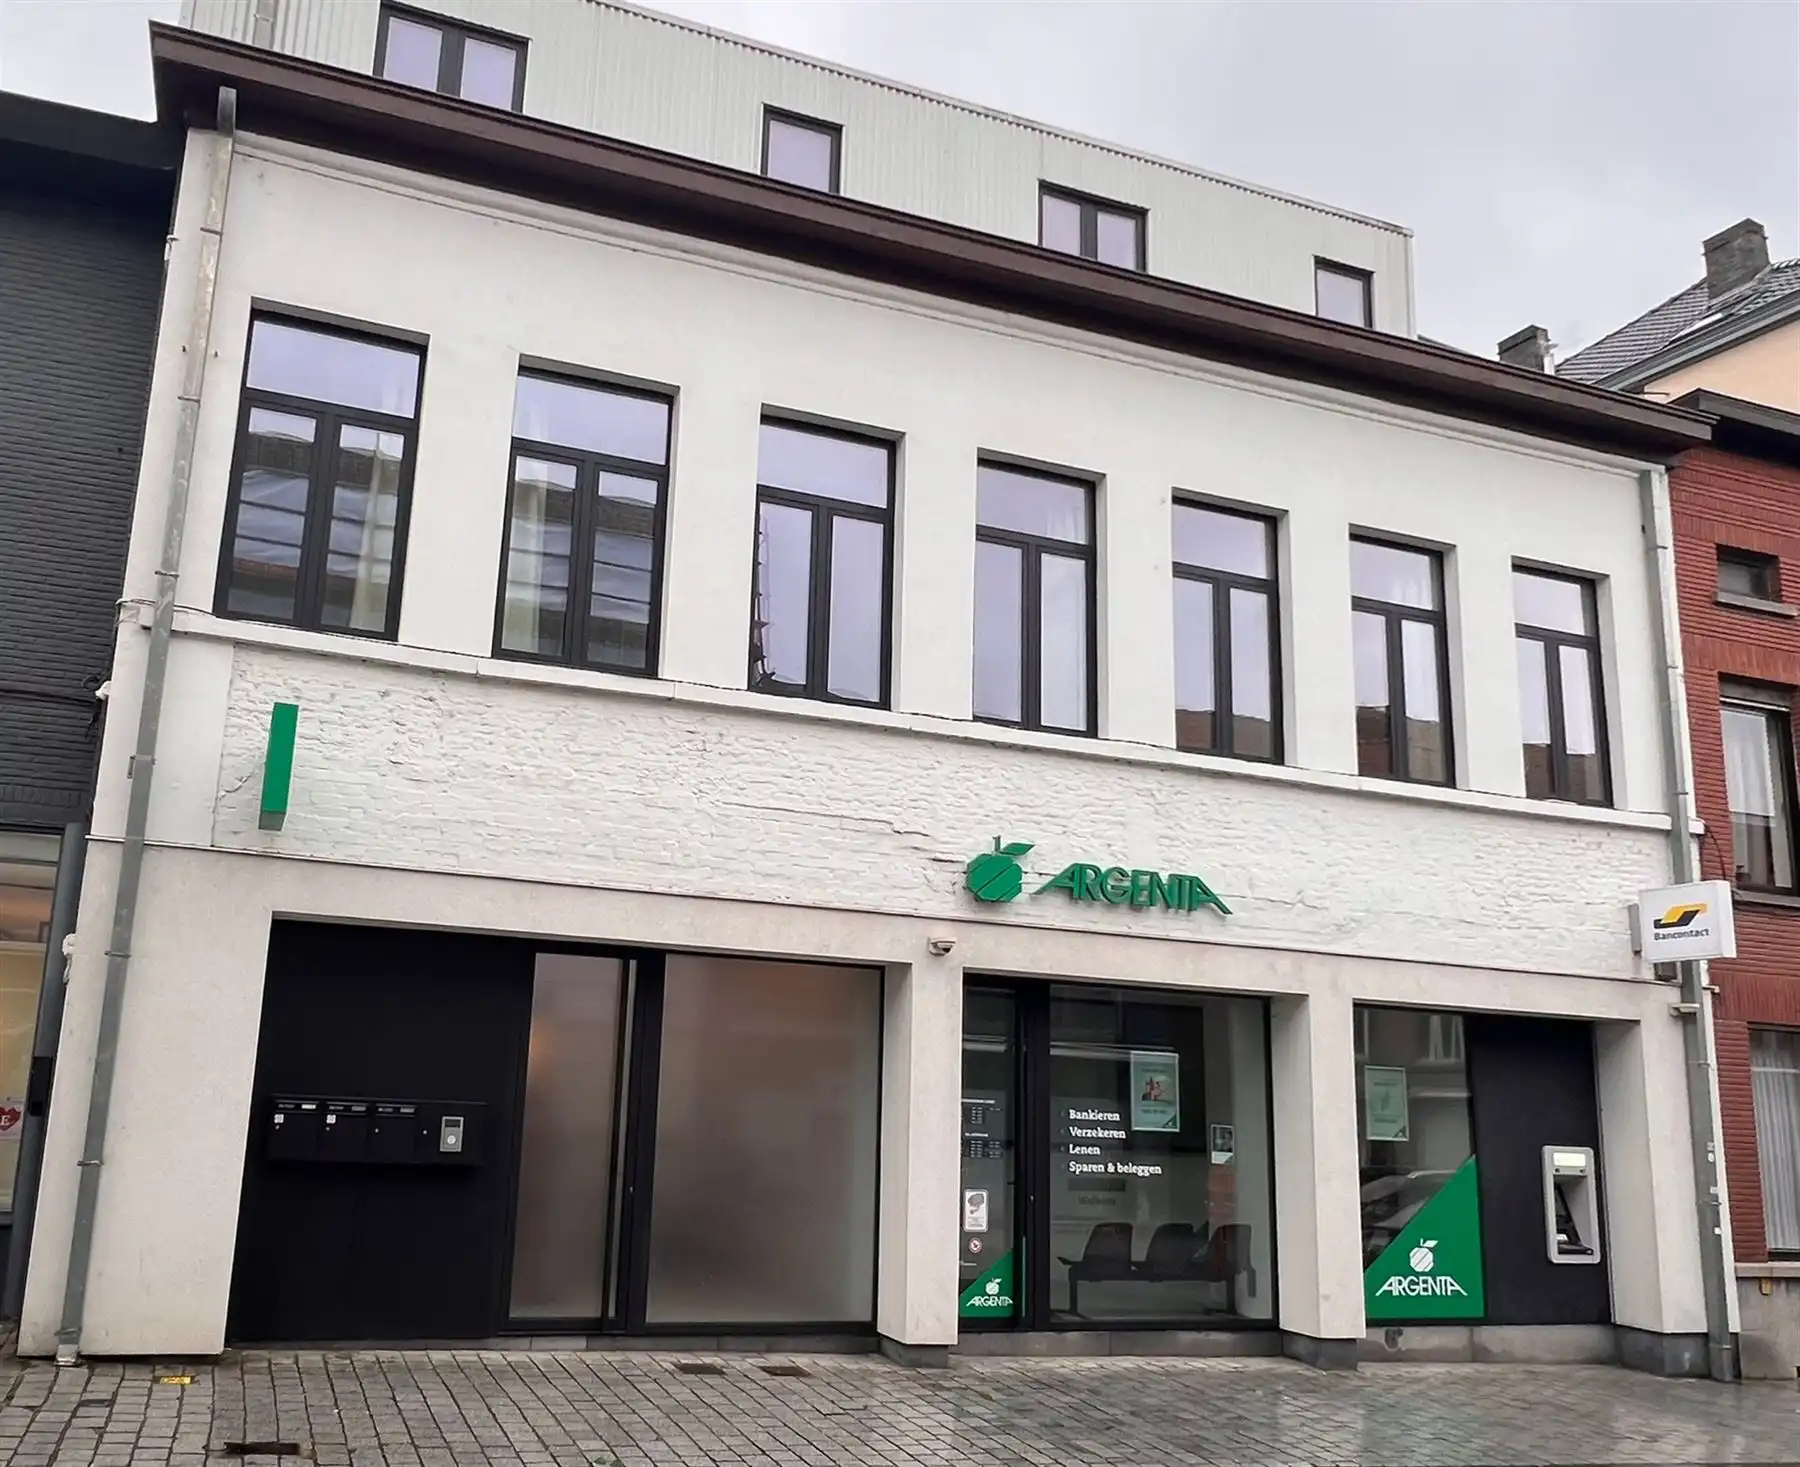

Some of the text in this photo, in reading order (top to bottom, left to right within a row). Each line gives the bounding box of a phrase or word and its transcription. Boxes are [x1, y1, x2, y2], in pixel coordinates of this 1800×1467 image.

[1030, 863, 1233, 915] ARGENTA
[1654, 928, 1710, 941] Bancontact
[1069, 1109, 1120, 1121] Bankieren
[1069, 1126, 1126, 1138] Verzekeren
[1069, 1144, 1101, 1155] Lenen
[1069, 1161, 1162, 1176] Sparen & beleggen
[1375, 1275, 1468, 1296] ARGENTA
[966, 1295, 1014, 1307] ARGENTA
